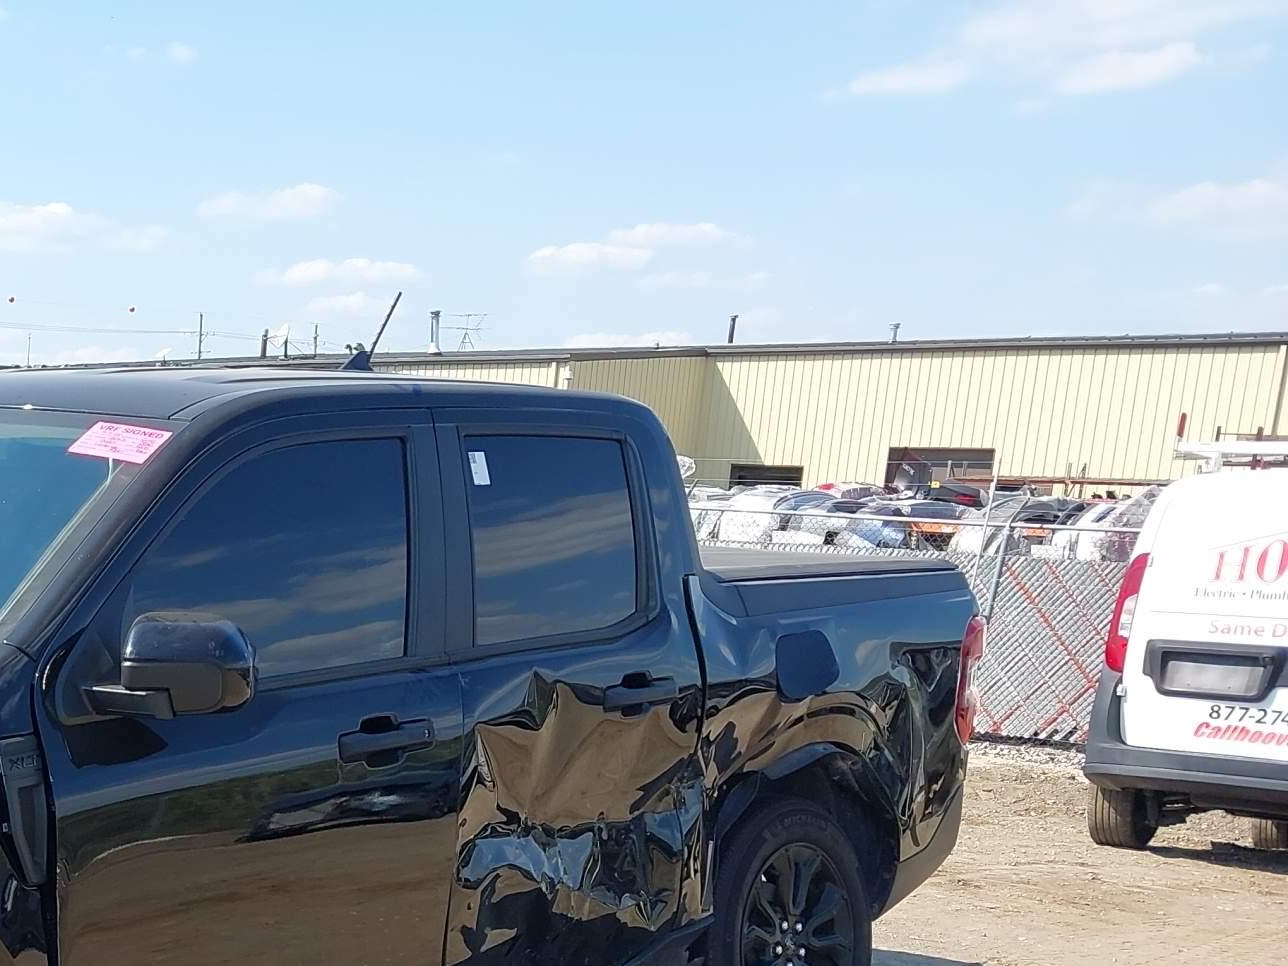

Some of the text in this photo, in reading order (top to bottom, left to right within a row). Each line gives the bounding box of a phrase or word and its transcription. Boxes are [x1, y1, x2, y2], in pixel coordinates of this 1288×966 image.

[99, 424, 165, 440] VRF SIGNED
[1207, 620, 1265, 637] Same
[1208, 704, 1288, 726] 877-274
